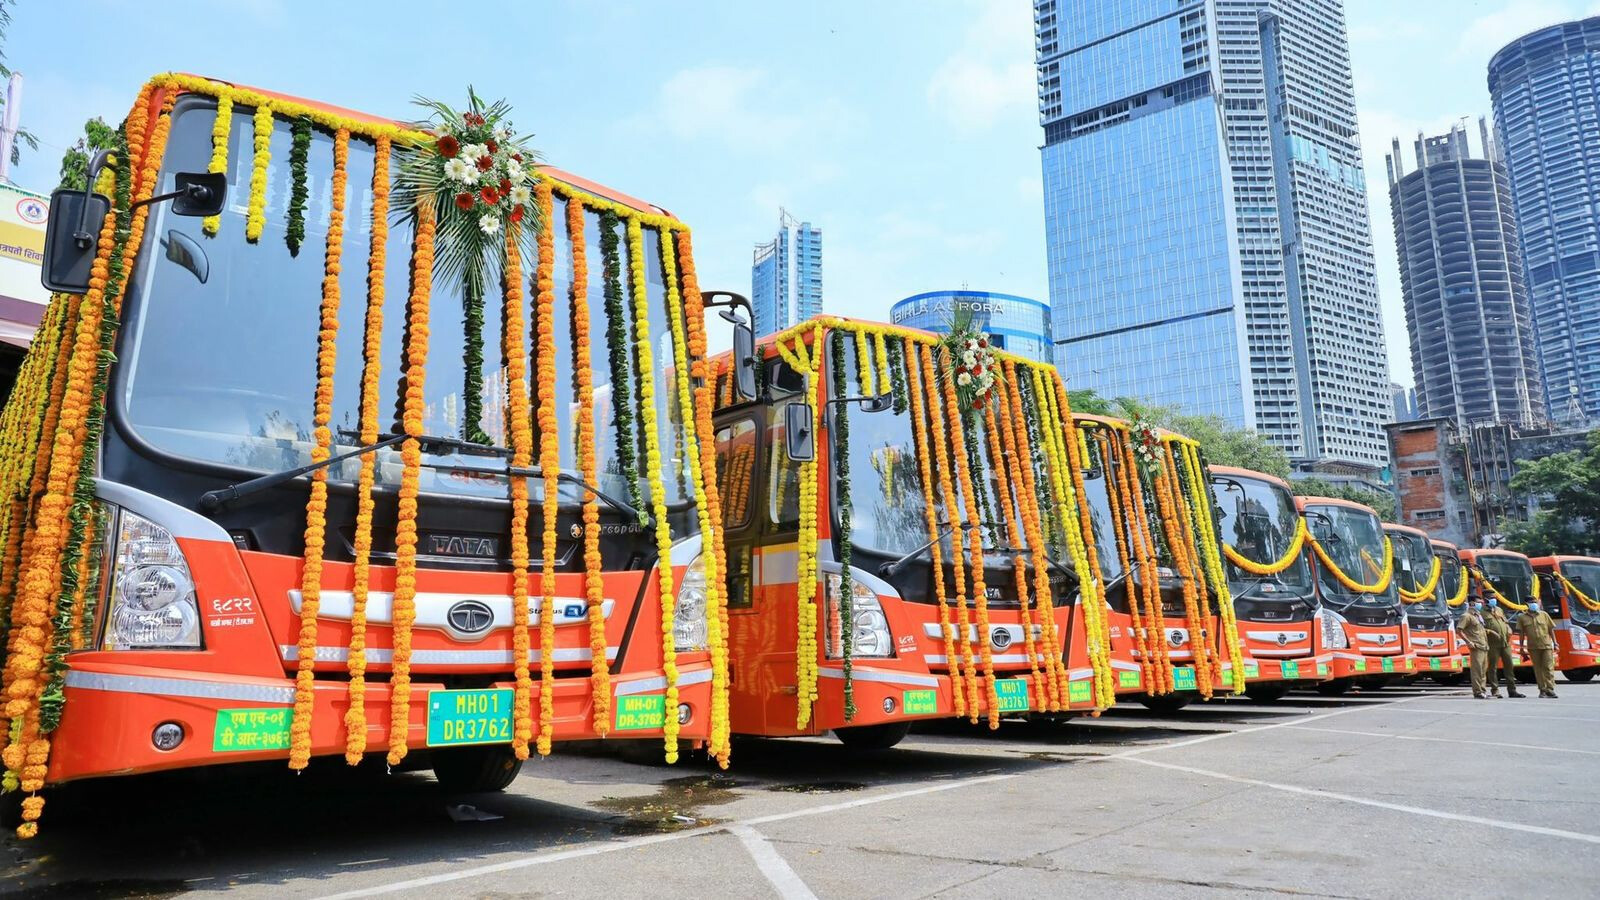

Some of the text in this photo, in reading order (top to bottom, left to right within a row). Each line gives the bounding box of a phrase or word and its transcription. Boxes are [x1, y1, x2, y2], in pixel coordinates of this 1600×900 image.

[24, 248, 44, 261] शिवा
[894, 305, 929, 324] BIRLA
[431, 535, 495, 555] TATA
[213, 597, 253, 613] ६८२२
[528, 607, 562, 615] Staus
[456, 693, 499, 714] MH01
[625, 699, 658, 711] MH-01
[618, 714, 662, 726] DR-3762
[443, 718, 509, 741] DR3762
